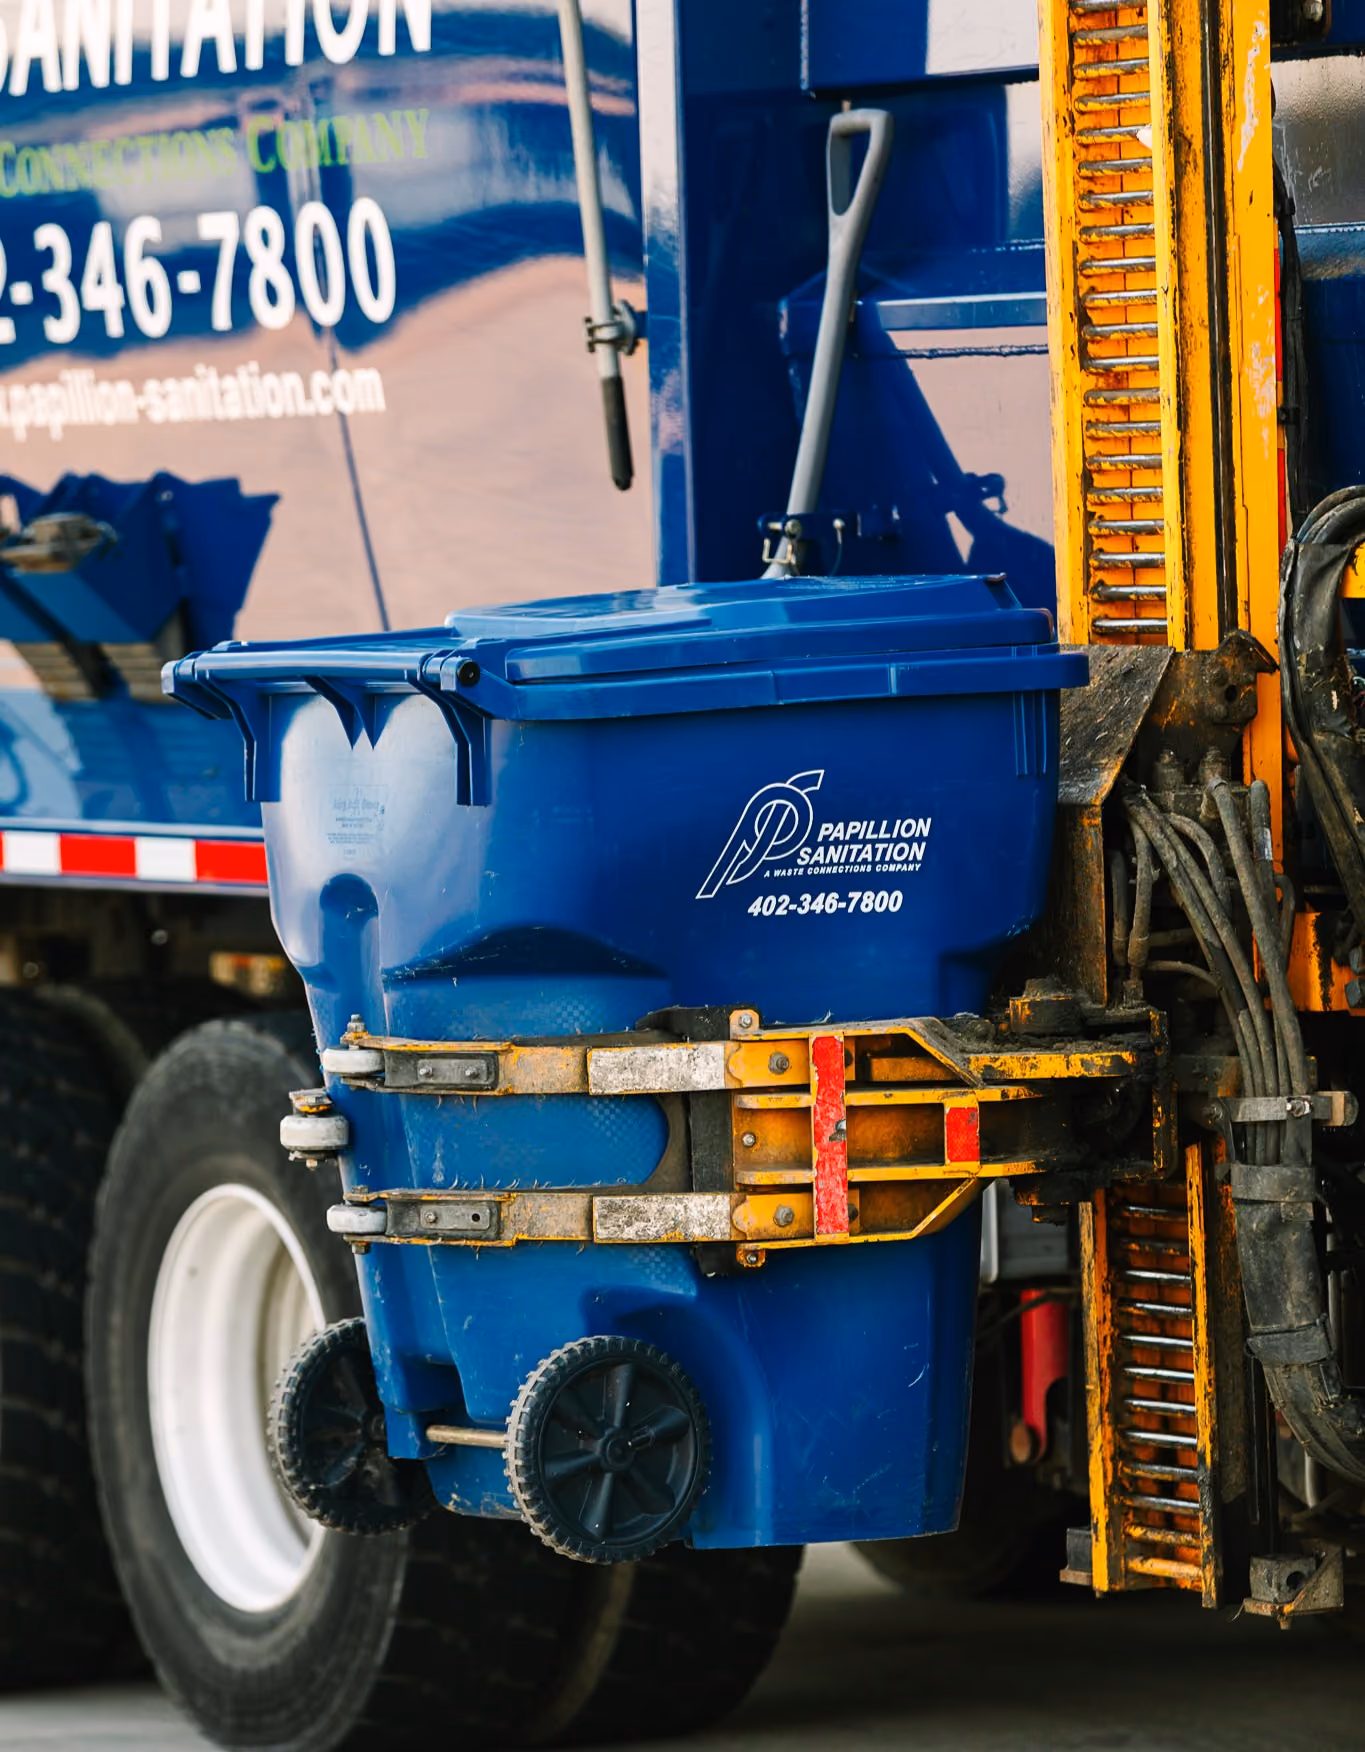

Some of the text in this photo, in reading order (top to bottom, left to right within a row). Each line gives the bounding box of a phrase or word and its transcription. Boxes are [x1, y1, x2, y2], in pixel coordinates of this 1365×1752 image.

[0, 0, 432, 97] ANITATION
[247, 108, 429, 173] COMPANY
[817, 817, 932, 842] PAPILLION
[797, 842, 926, 866] SANITATION
[763, 863, 921, 878] A WASTE CONNECTIONS COMPANY
[747, 890, 903, 917] 402-346-7800
